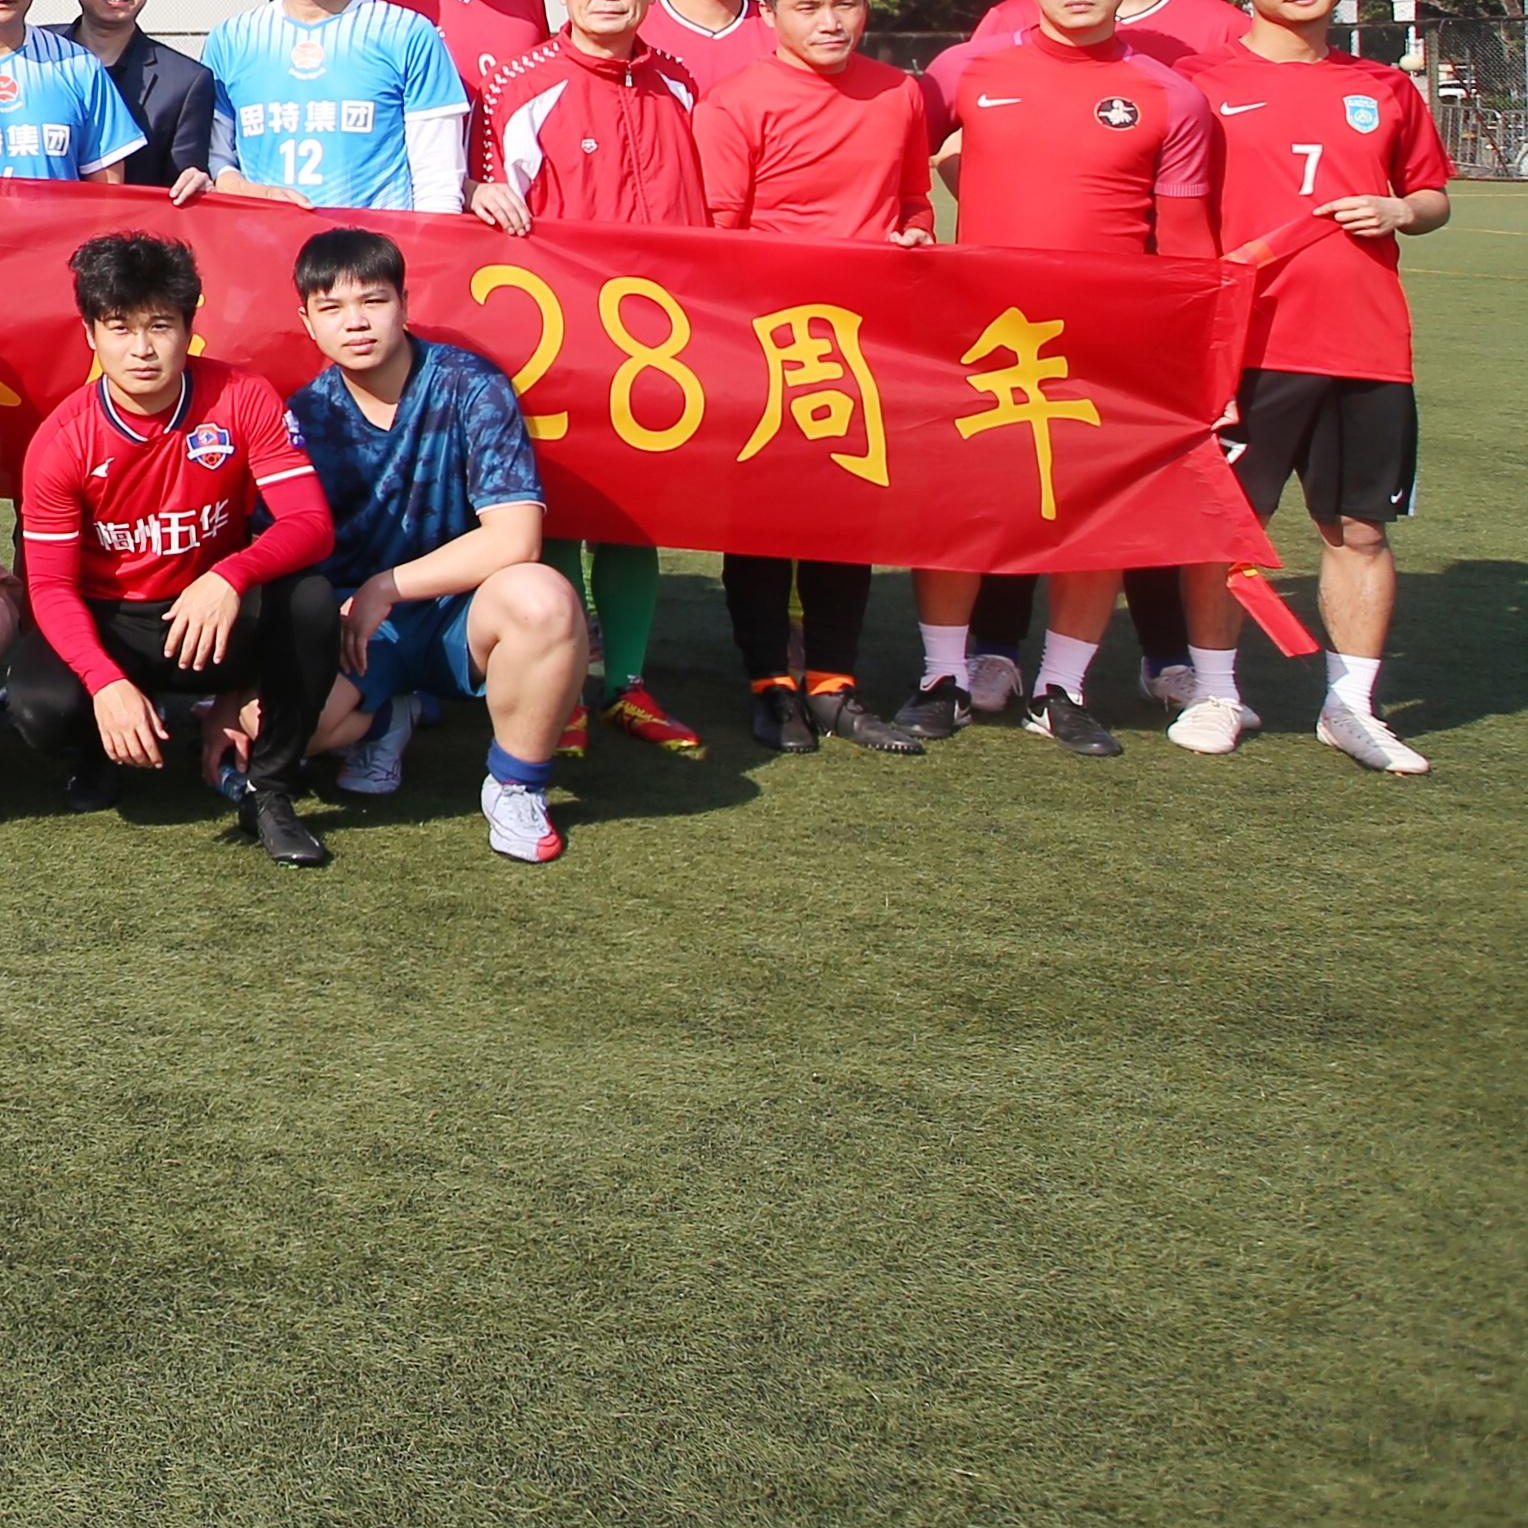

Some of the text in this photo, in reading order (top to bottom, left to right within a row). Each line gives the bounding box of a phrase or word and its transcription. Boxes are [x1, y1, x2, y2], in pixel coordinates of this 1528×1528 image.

[239, 99, 376, 137] 思特集团
[279, 138, 324, 185] 12
[1291, 144, 1323, 195] 7
[94, 498, 229, 556] 梅州五华
